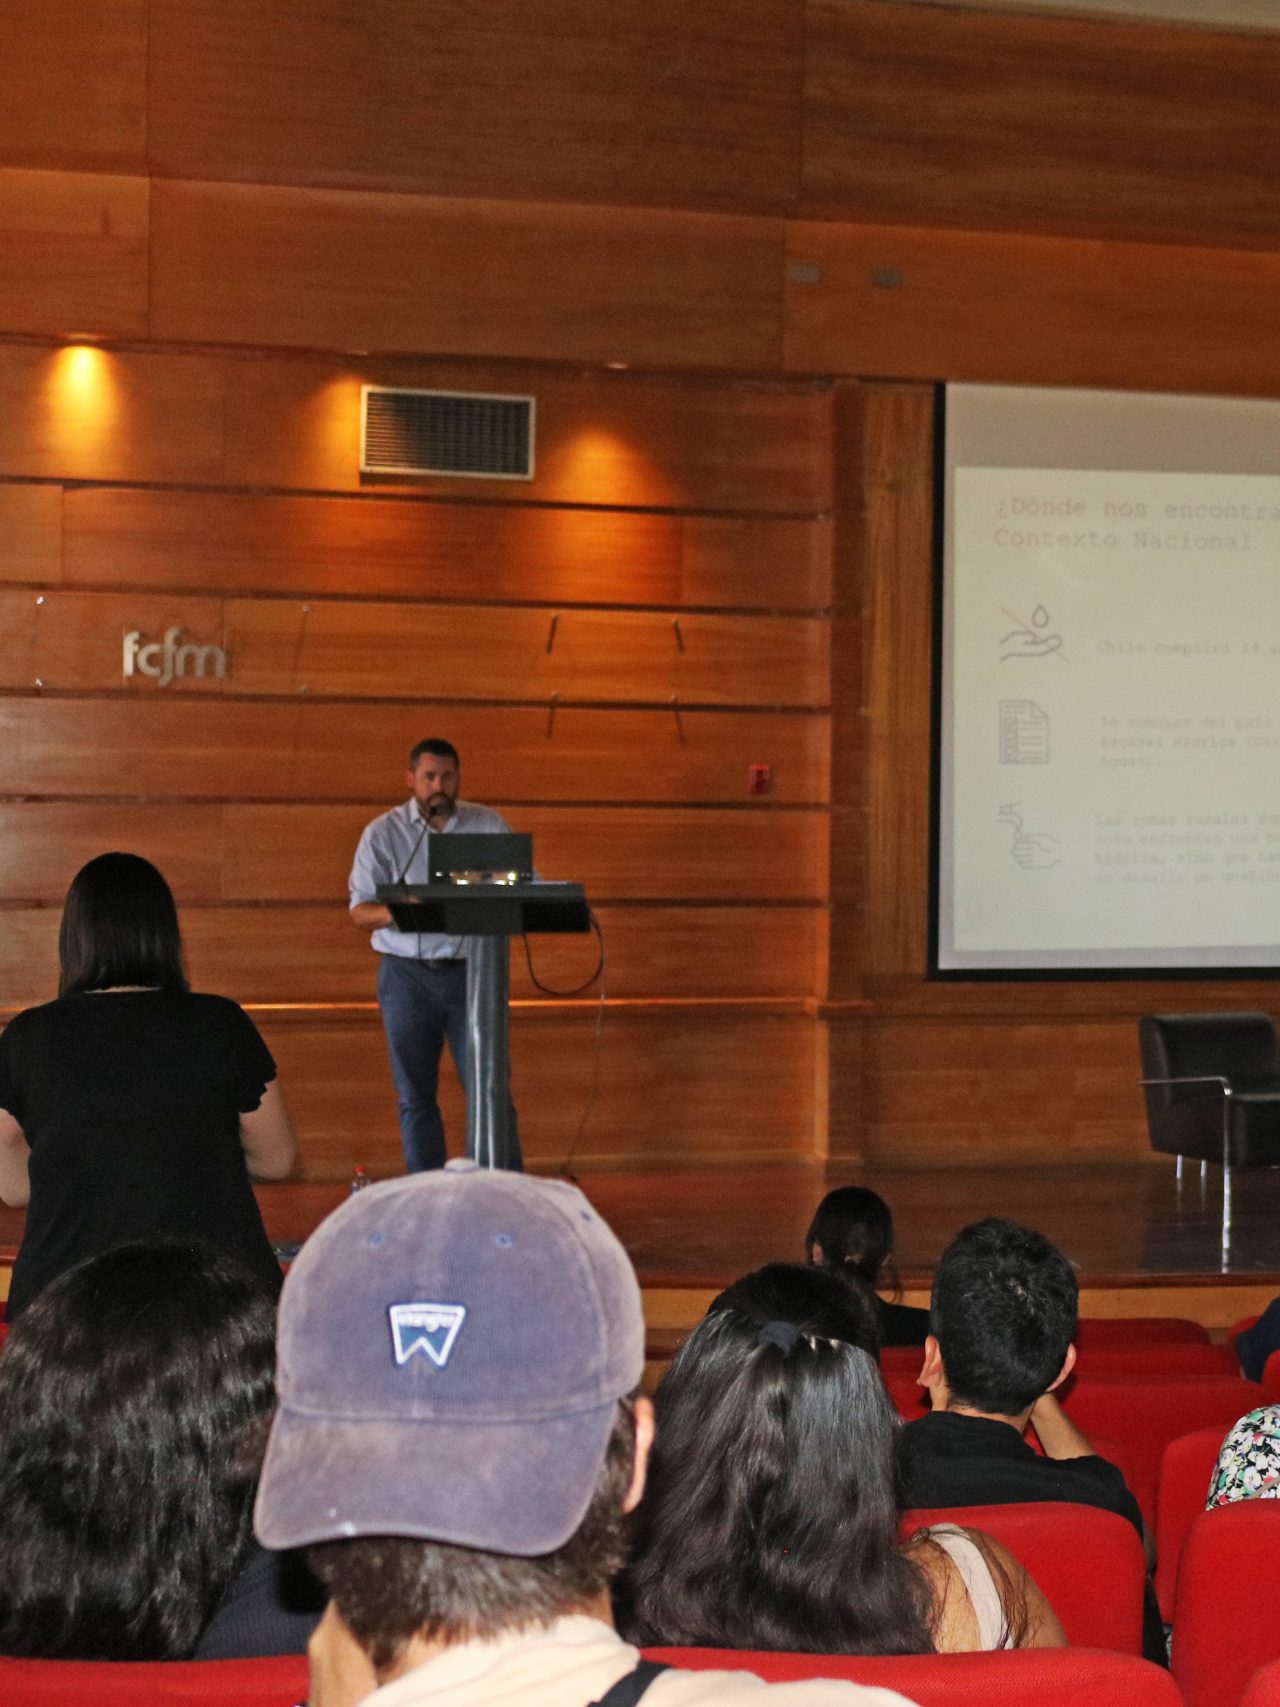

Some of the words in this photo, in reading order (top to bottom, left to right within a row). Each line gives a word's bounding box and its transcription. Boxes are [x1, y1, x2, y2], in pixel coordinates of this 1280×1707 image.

[995, 496, 1087, 520] ¿Dónde
[1103, 500, 1149, 518] nos
[993, 527, 1118, 550] Contexto
[1133, 530, 1252, 552] Nacional
[123, 627, 226, 687] fcfm
